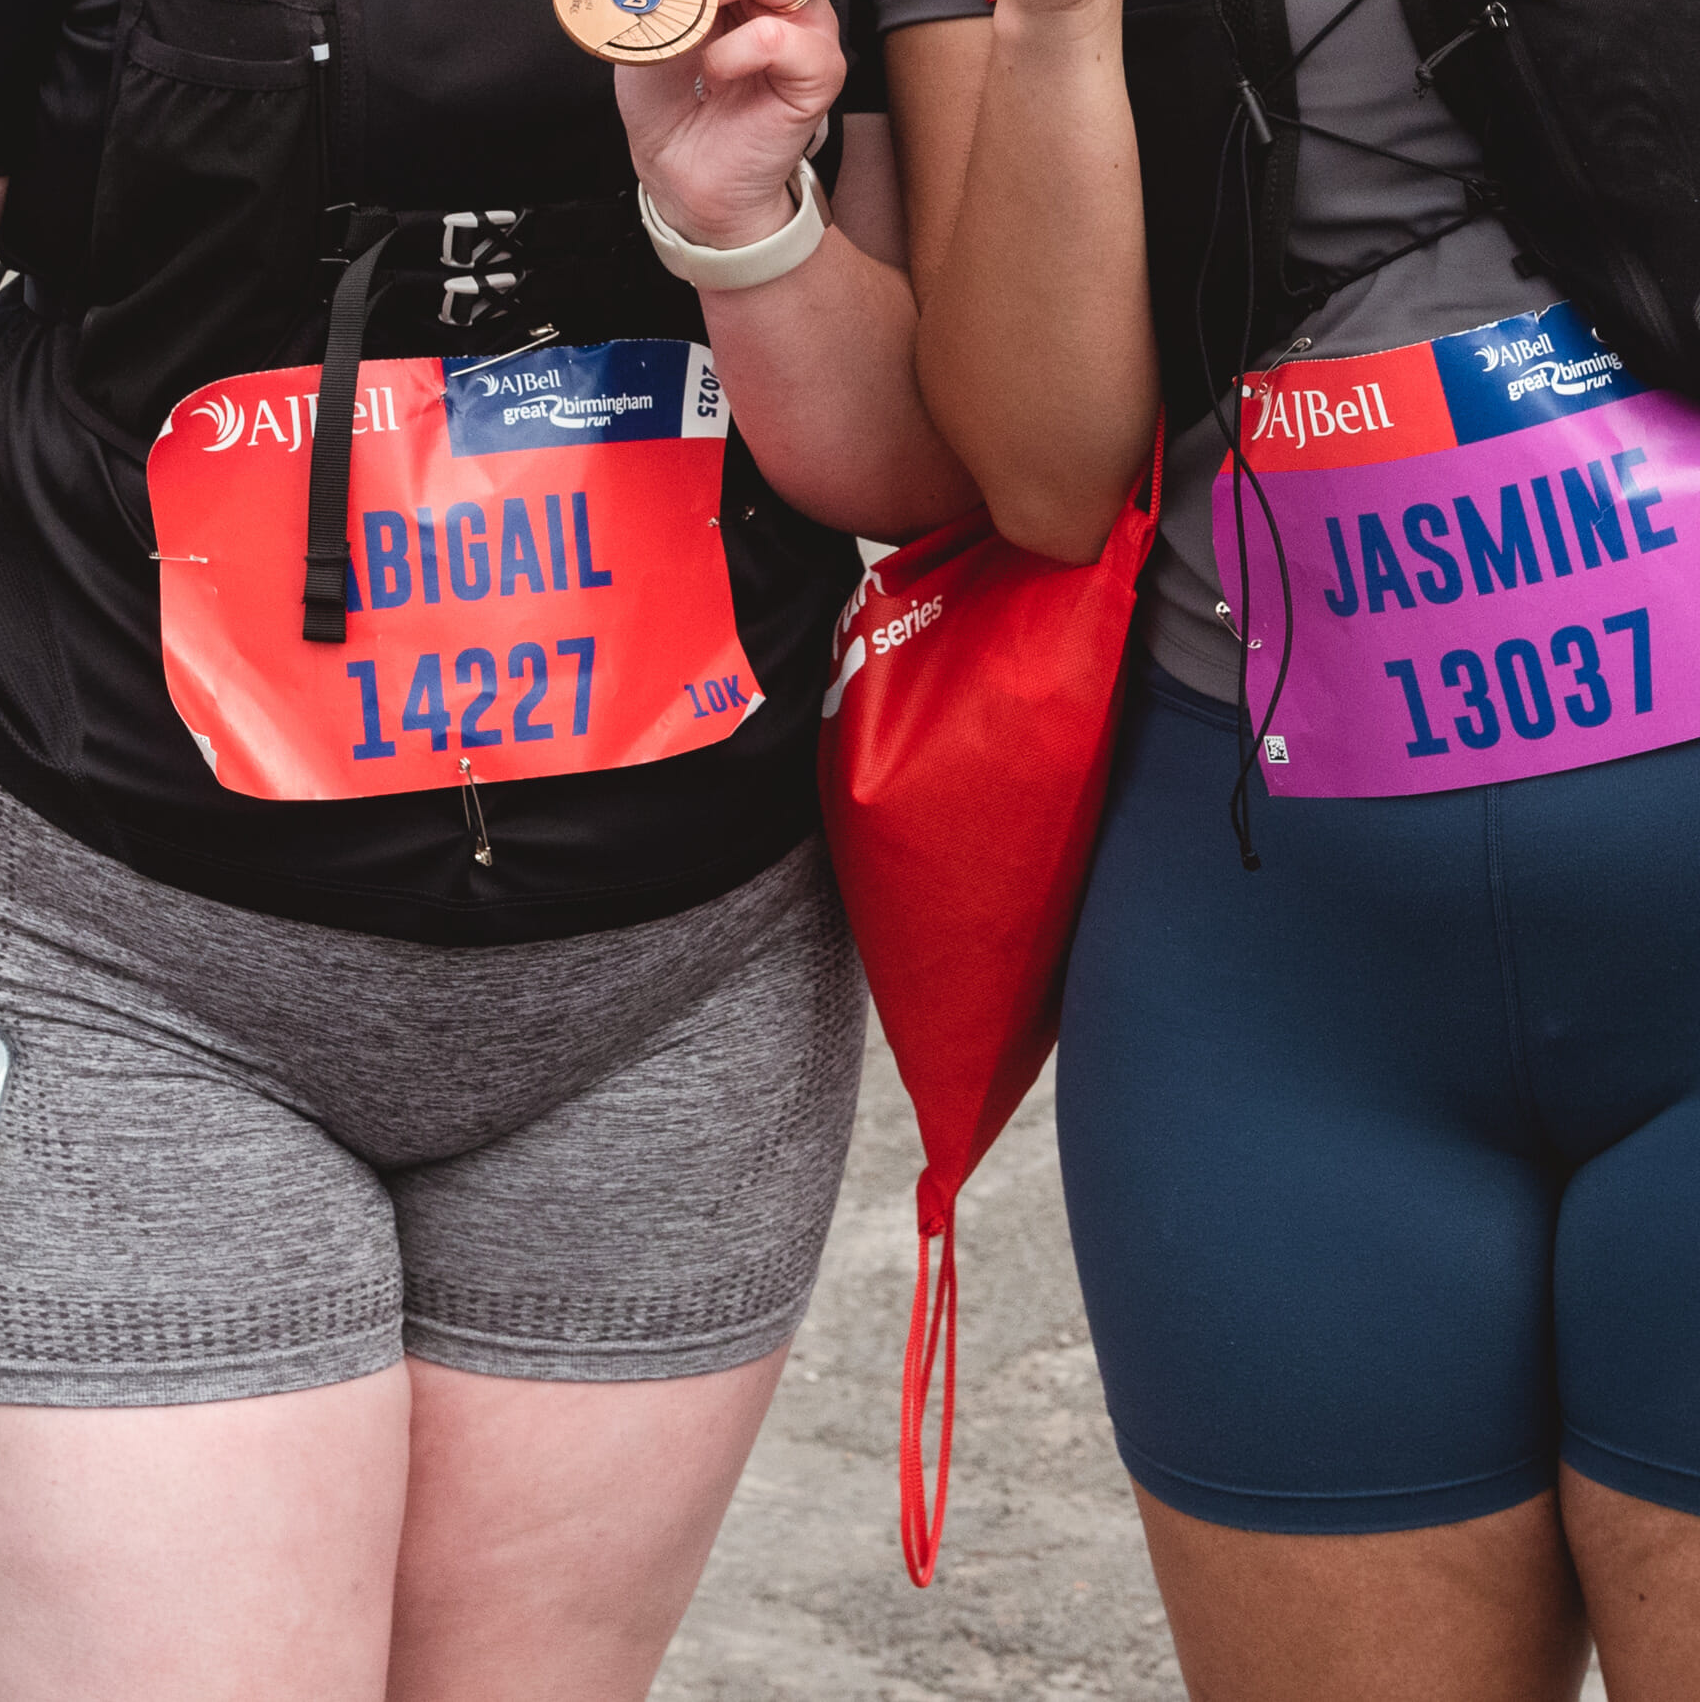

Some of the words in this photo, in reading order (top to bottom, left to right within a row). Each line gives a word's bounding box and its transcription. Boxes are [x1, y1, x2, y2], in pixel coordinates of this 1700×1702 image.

[1501, 333, 1556, 367] AJBell
[499, 369, 563, 396] AJBell
[697, 364, 721, 418] 2025
[1507, 369, 1551, 401] great
[1559, 352, 1623, 382] birming
[1586, 372, 1612, 391] run
[503, 401, 549, 426] great
[563, 393, 653, 416] birmingham
[586, 415, 612, 428] run
[1266, 383, 1395, 449] AJBell
[346, 491, 613, 613] BIGAIL
[1324, 446, 1678, 618] JASMINE
[871, 595, 943, 655] series
[346, 636, 596, 761] 14227
[683, 674, 750, 719] 10K
[1384, 607, 1654, 759] 13037
